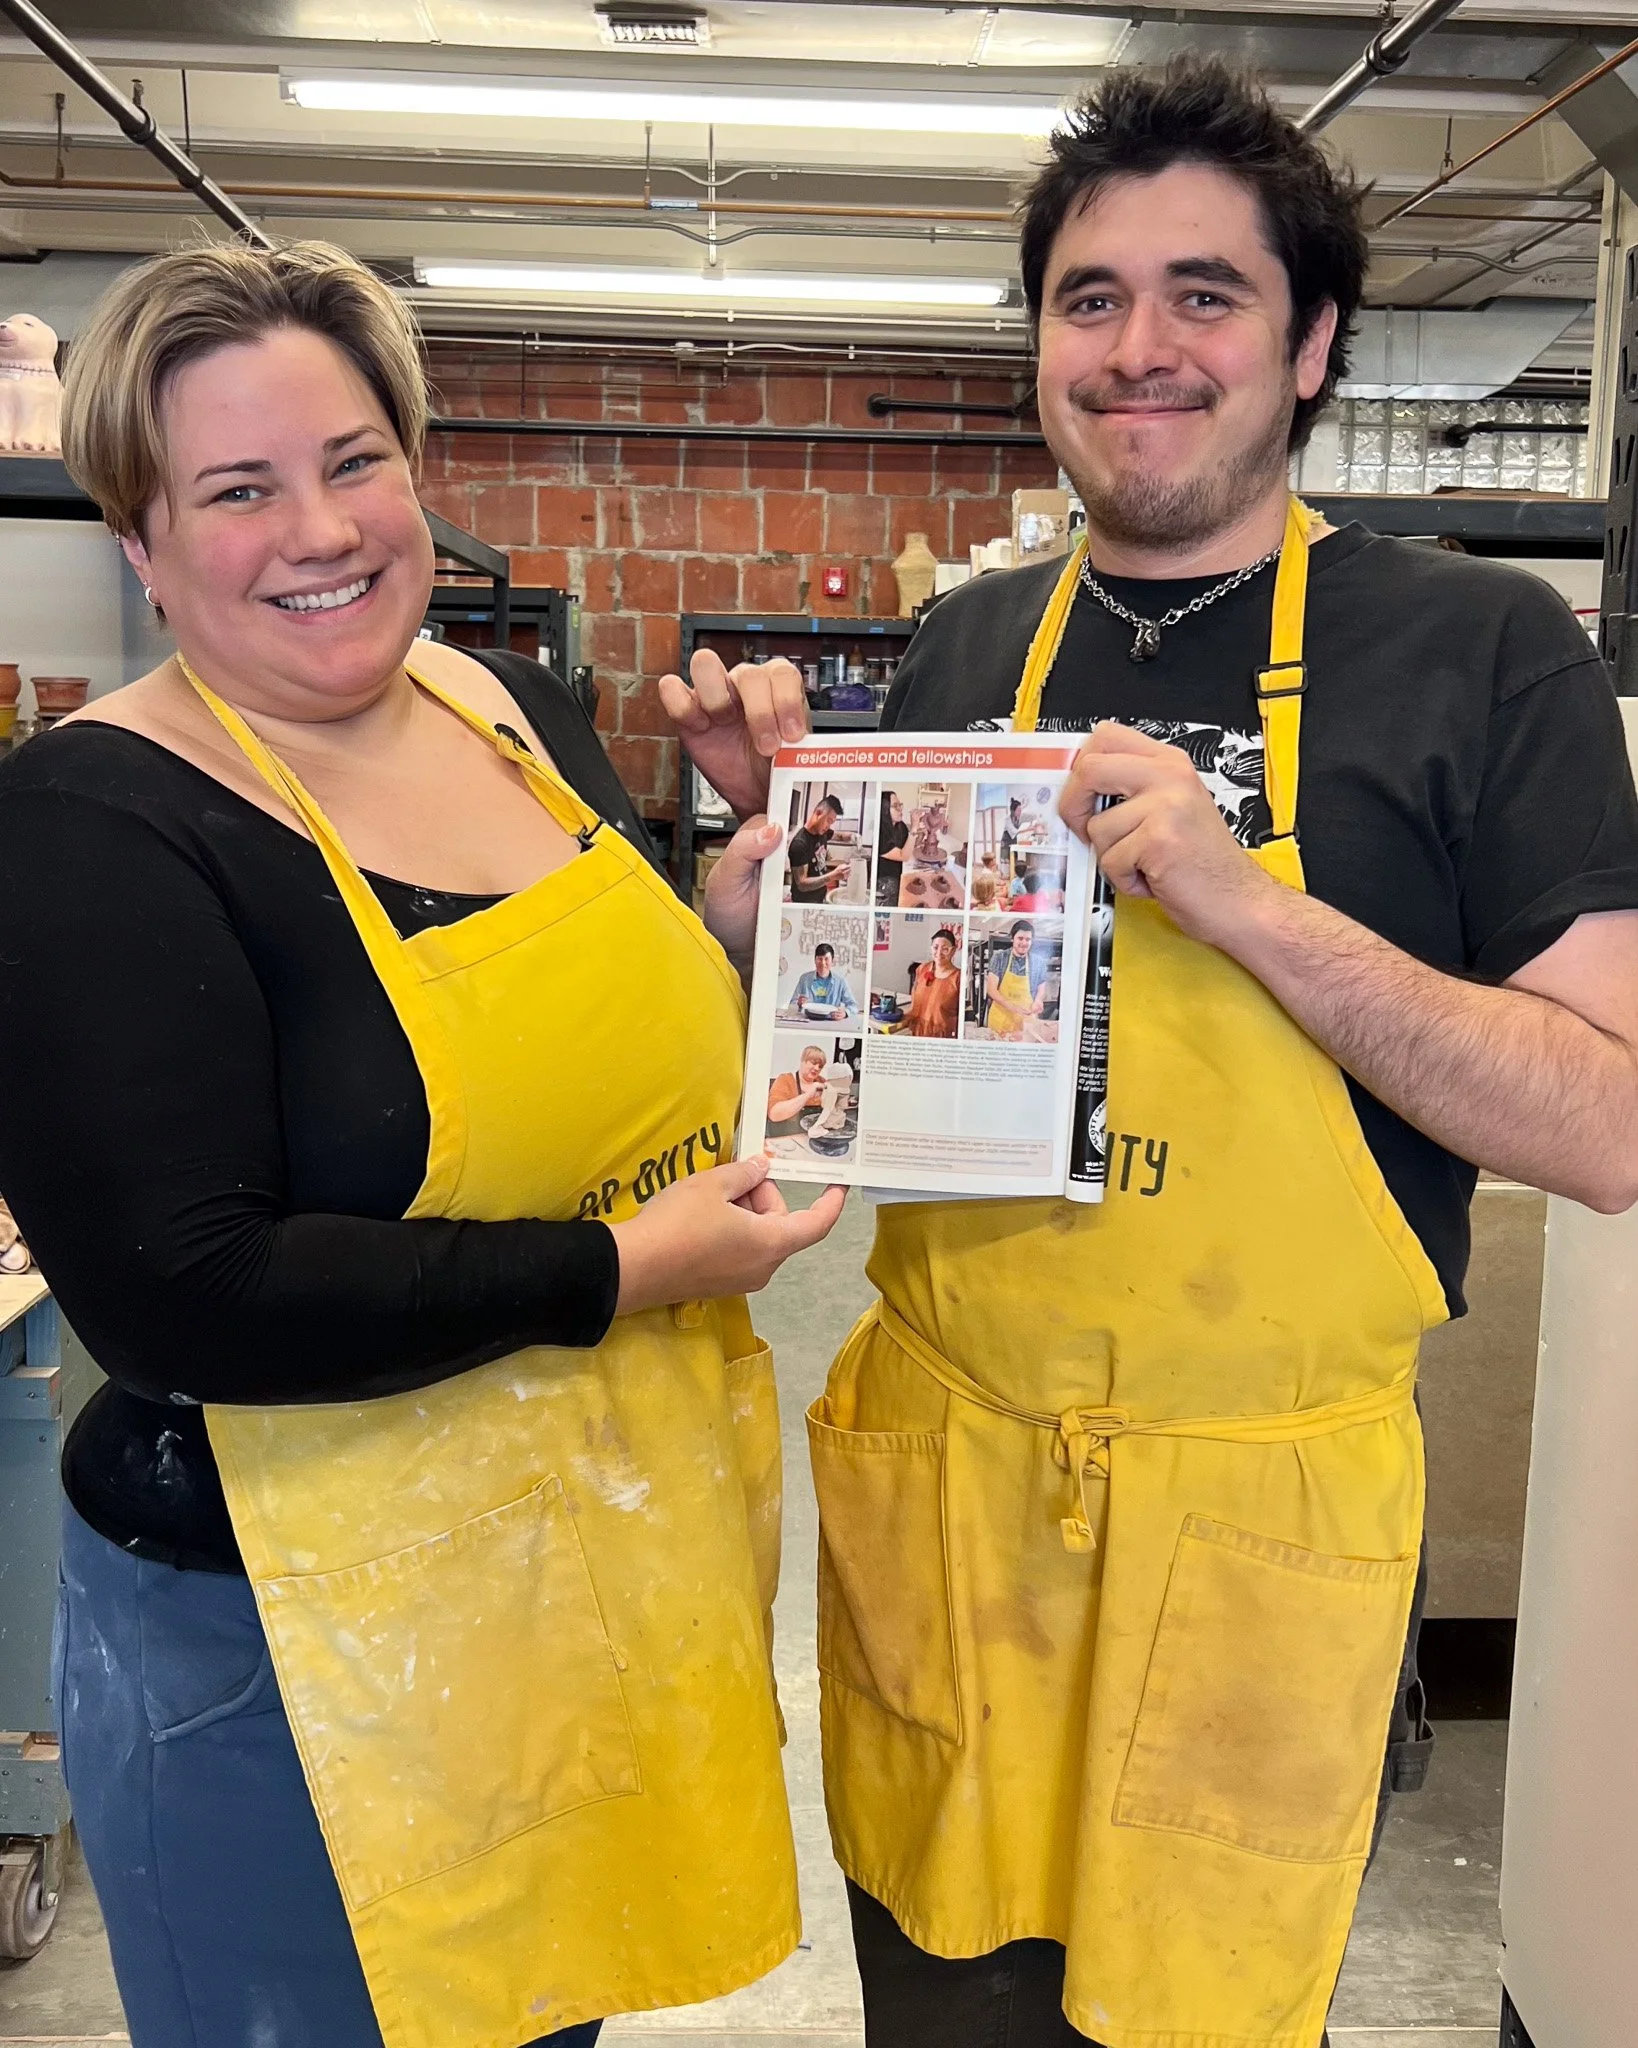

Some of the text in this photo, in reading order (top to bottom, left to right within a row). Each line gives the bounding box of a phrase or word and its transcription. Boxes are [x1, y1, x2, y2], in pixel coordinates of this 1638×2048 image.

[796, 750, 993, 767] residencies and fellowships
